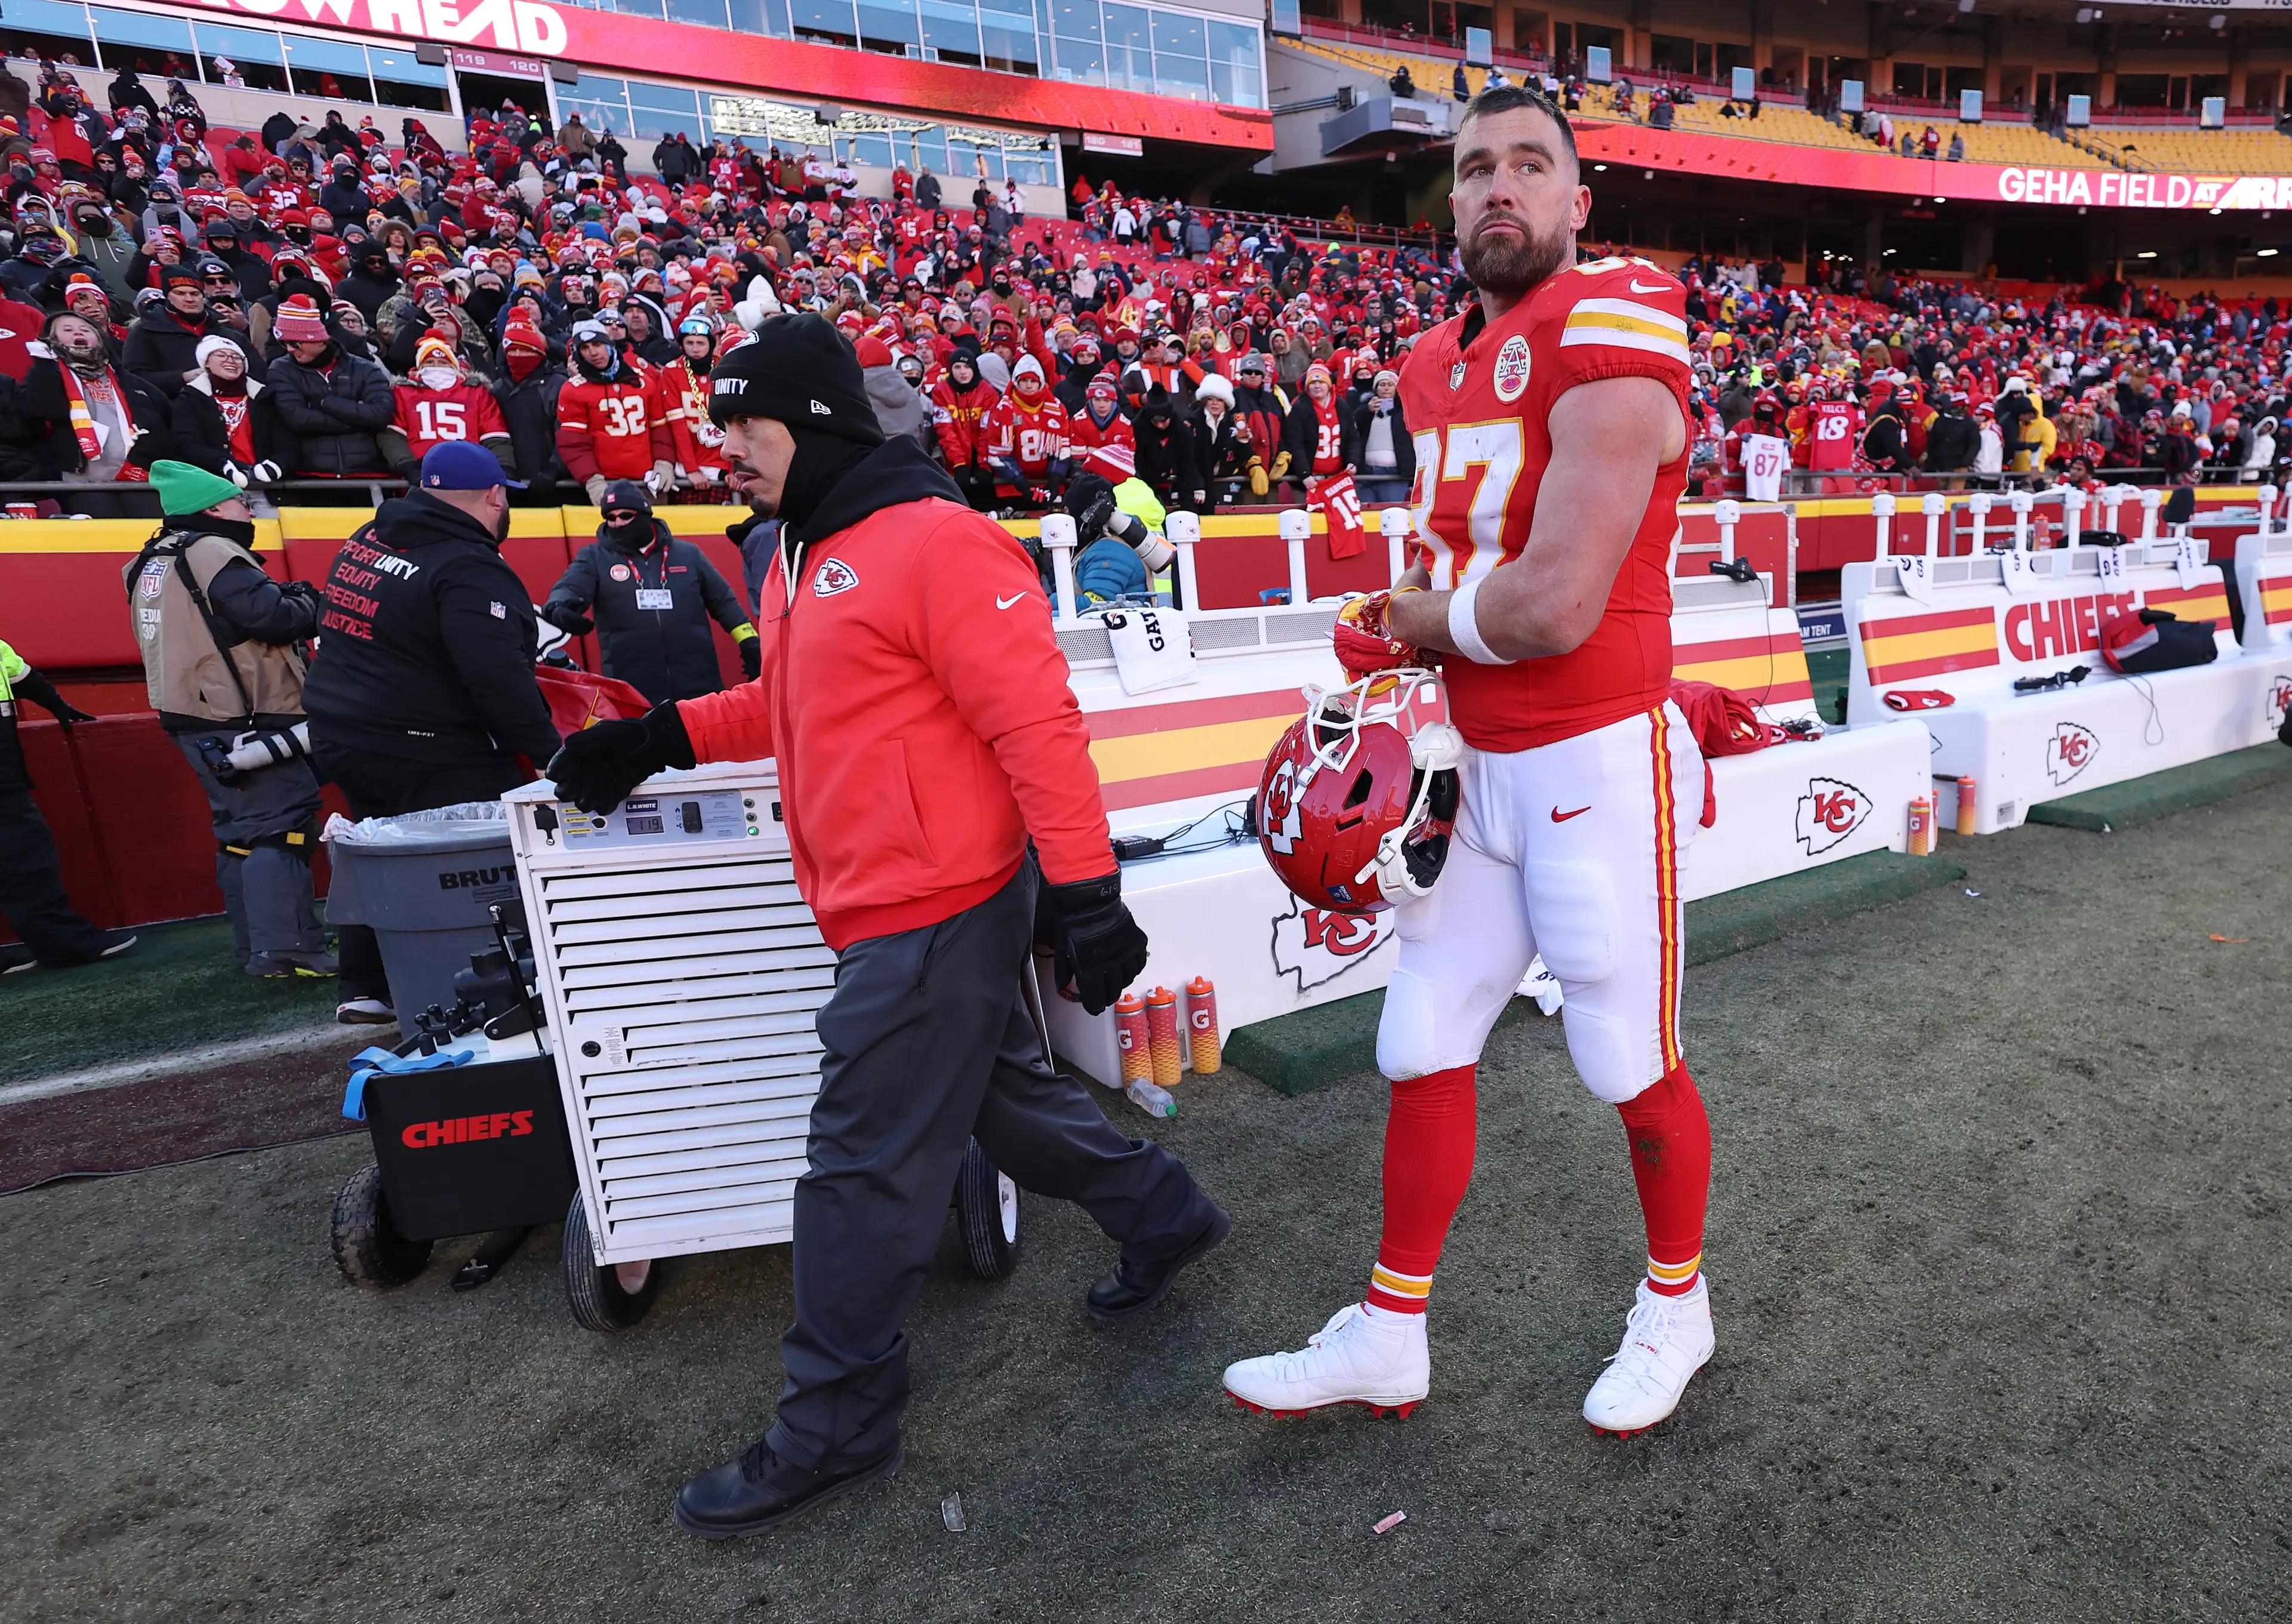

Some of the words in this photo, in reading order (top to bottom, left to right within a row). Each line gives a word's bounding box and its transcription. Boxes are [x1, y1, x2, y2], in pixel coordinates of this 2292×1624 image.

[456, 53, 485, 66] 119
[510, 60, 540, 73] 120
[269, 190, 298, 209] 32
[1998, 168, 2092, 205] GEHA
[2099, 173, 2192, 208] FIELD
[2192, 183, 2223, 202] AT
[899, 221, 916, 238] 15
[1498, 341, 1527, 378] A
[714, 378, 748, 395] UNITY
[415, 401, 467, 440] 15
[599, 396, 645, 437] 32
[1817, 416, 1849, 440] 18
[1754, 454, 1779, 477] 87
[1332, 489, 1364, 530] 15
[142, 575, 159, 594] NFL
[335, 562, 382, 590] EQUITY
[824, 567, 848, 588] KC
[325, 583, 380, 618] FREEDOM
[142, 623, 156, 640] 39
[1811, 624, 1832, 637] TENT
[2060, 732, 2088, 767] KC
[1268, 774, 1293, 834] KC
[1813, 791, 1856, 832] KC
[1910, 817, 1920, 830] G
[1302, 908, 1378, 956] KC
[1192, 1009, 1210, 1029] G
[1117, 1029, 1133, 1049] G
[402, 1110, 534, 1148] CHIEFS
